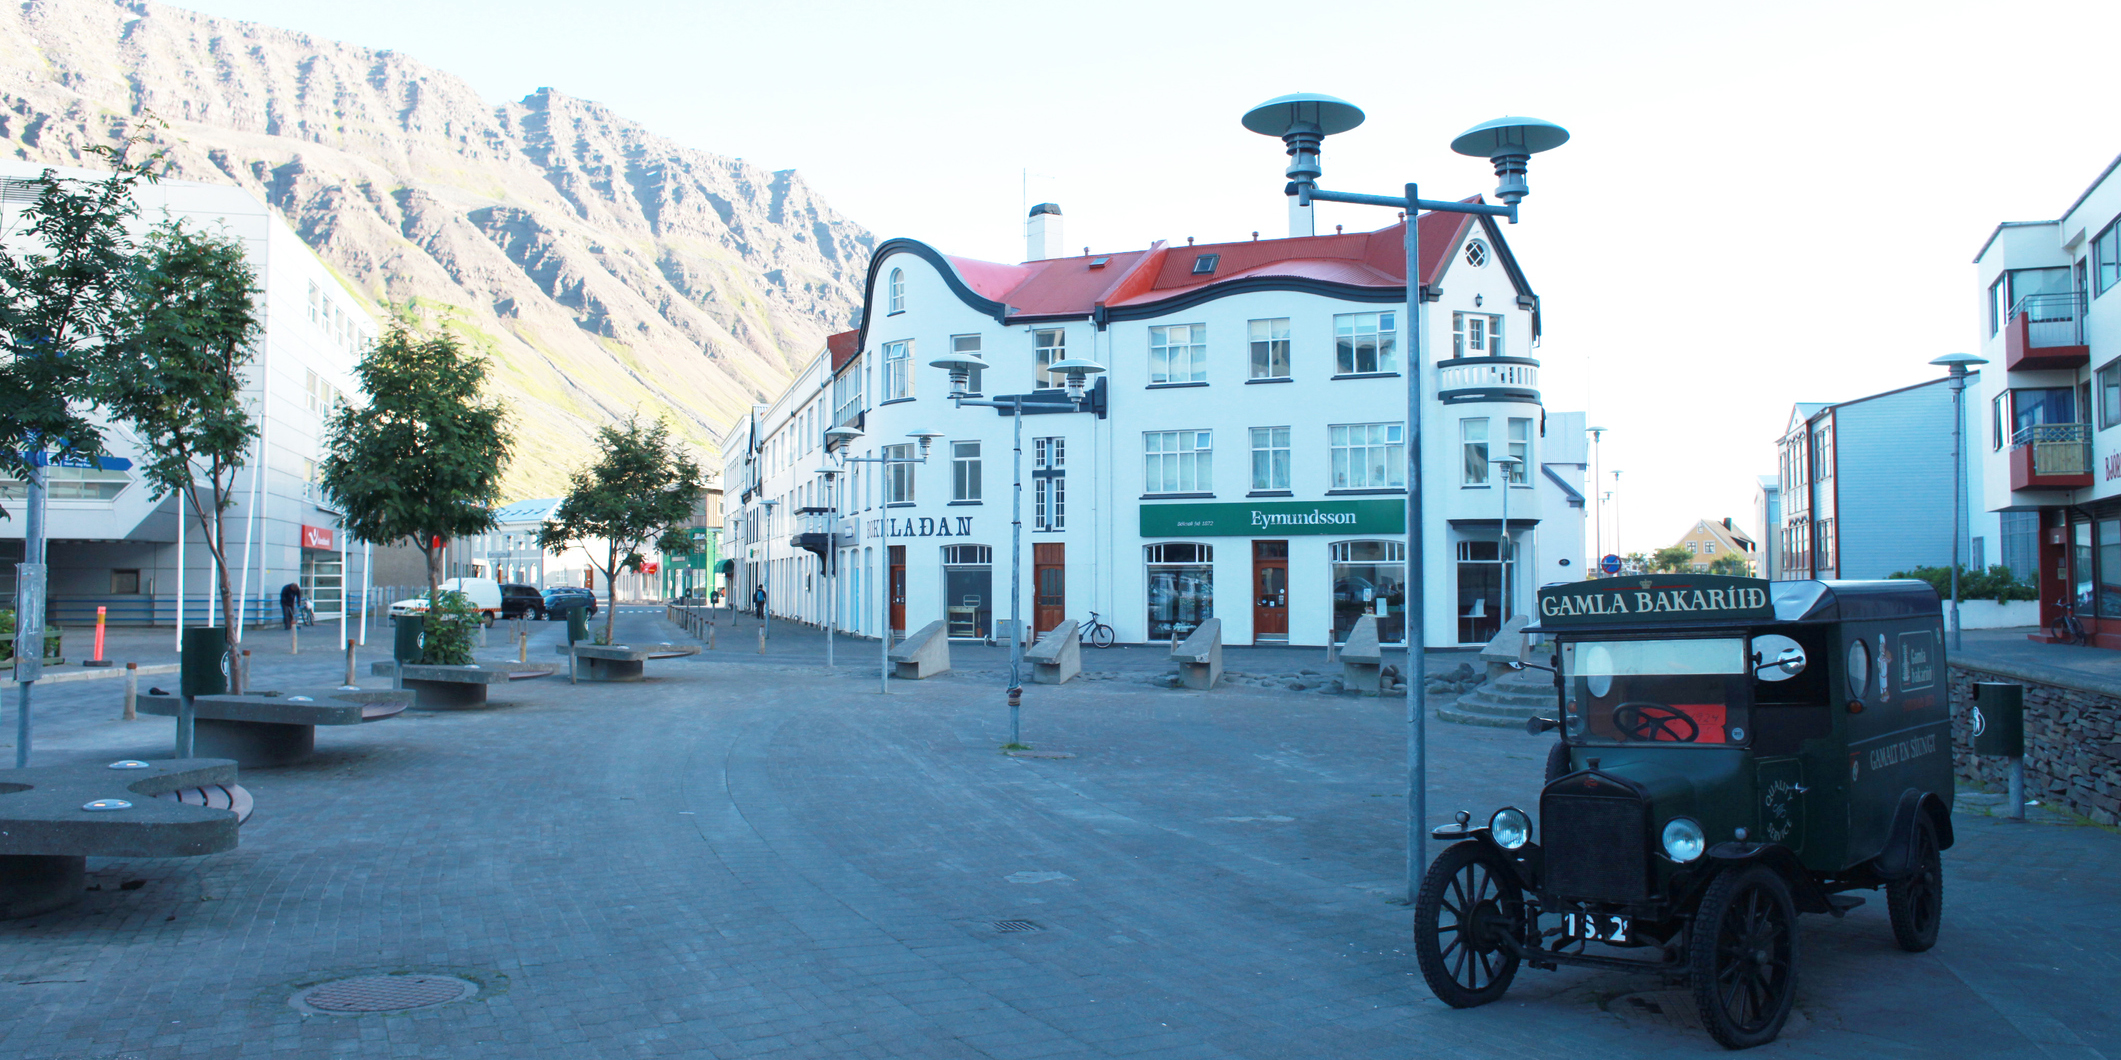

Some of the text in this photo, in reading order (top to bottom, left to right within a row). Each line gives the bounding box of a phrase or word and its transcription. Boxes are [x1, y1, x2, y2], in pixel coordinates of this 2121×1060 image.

[1251, 509, 1357, 529] Eymundsson
[1541, 585, 1767, 617] GAMLA BAKARÍIÐ
[1767, 819, 1792, 841] SERVICE
